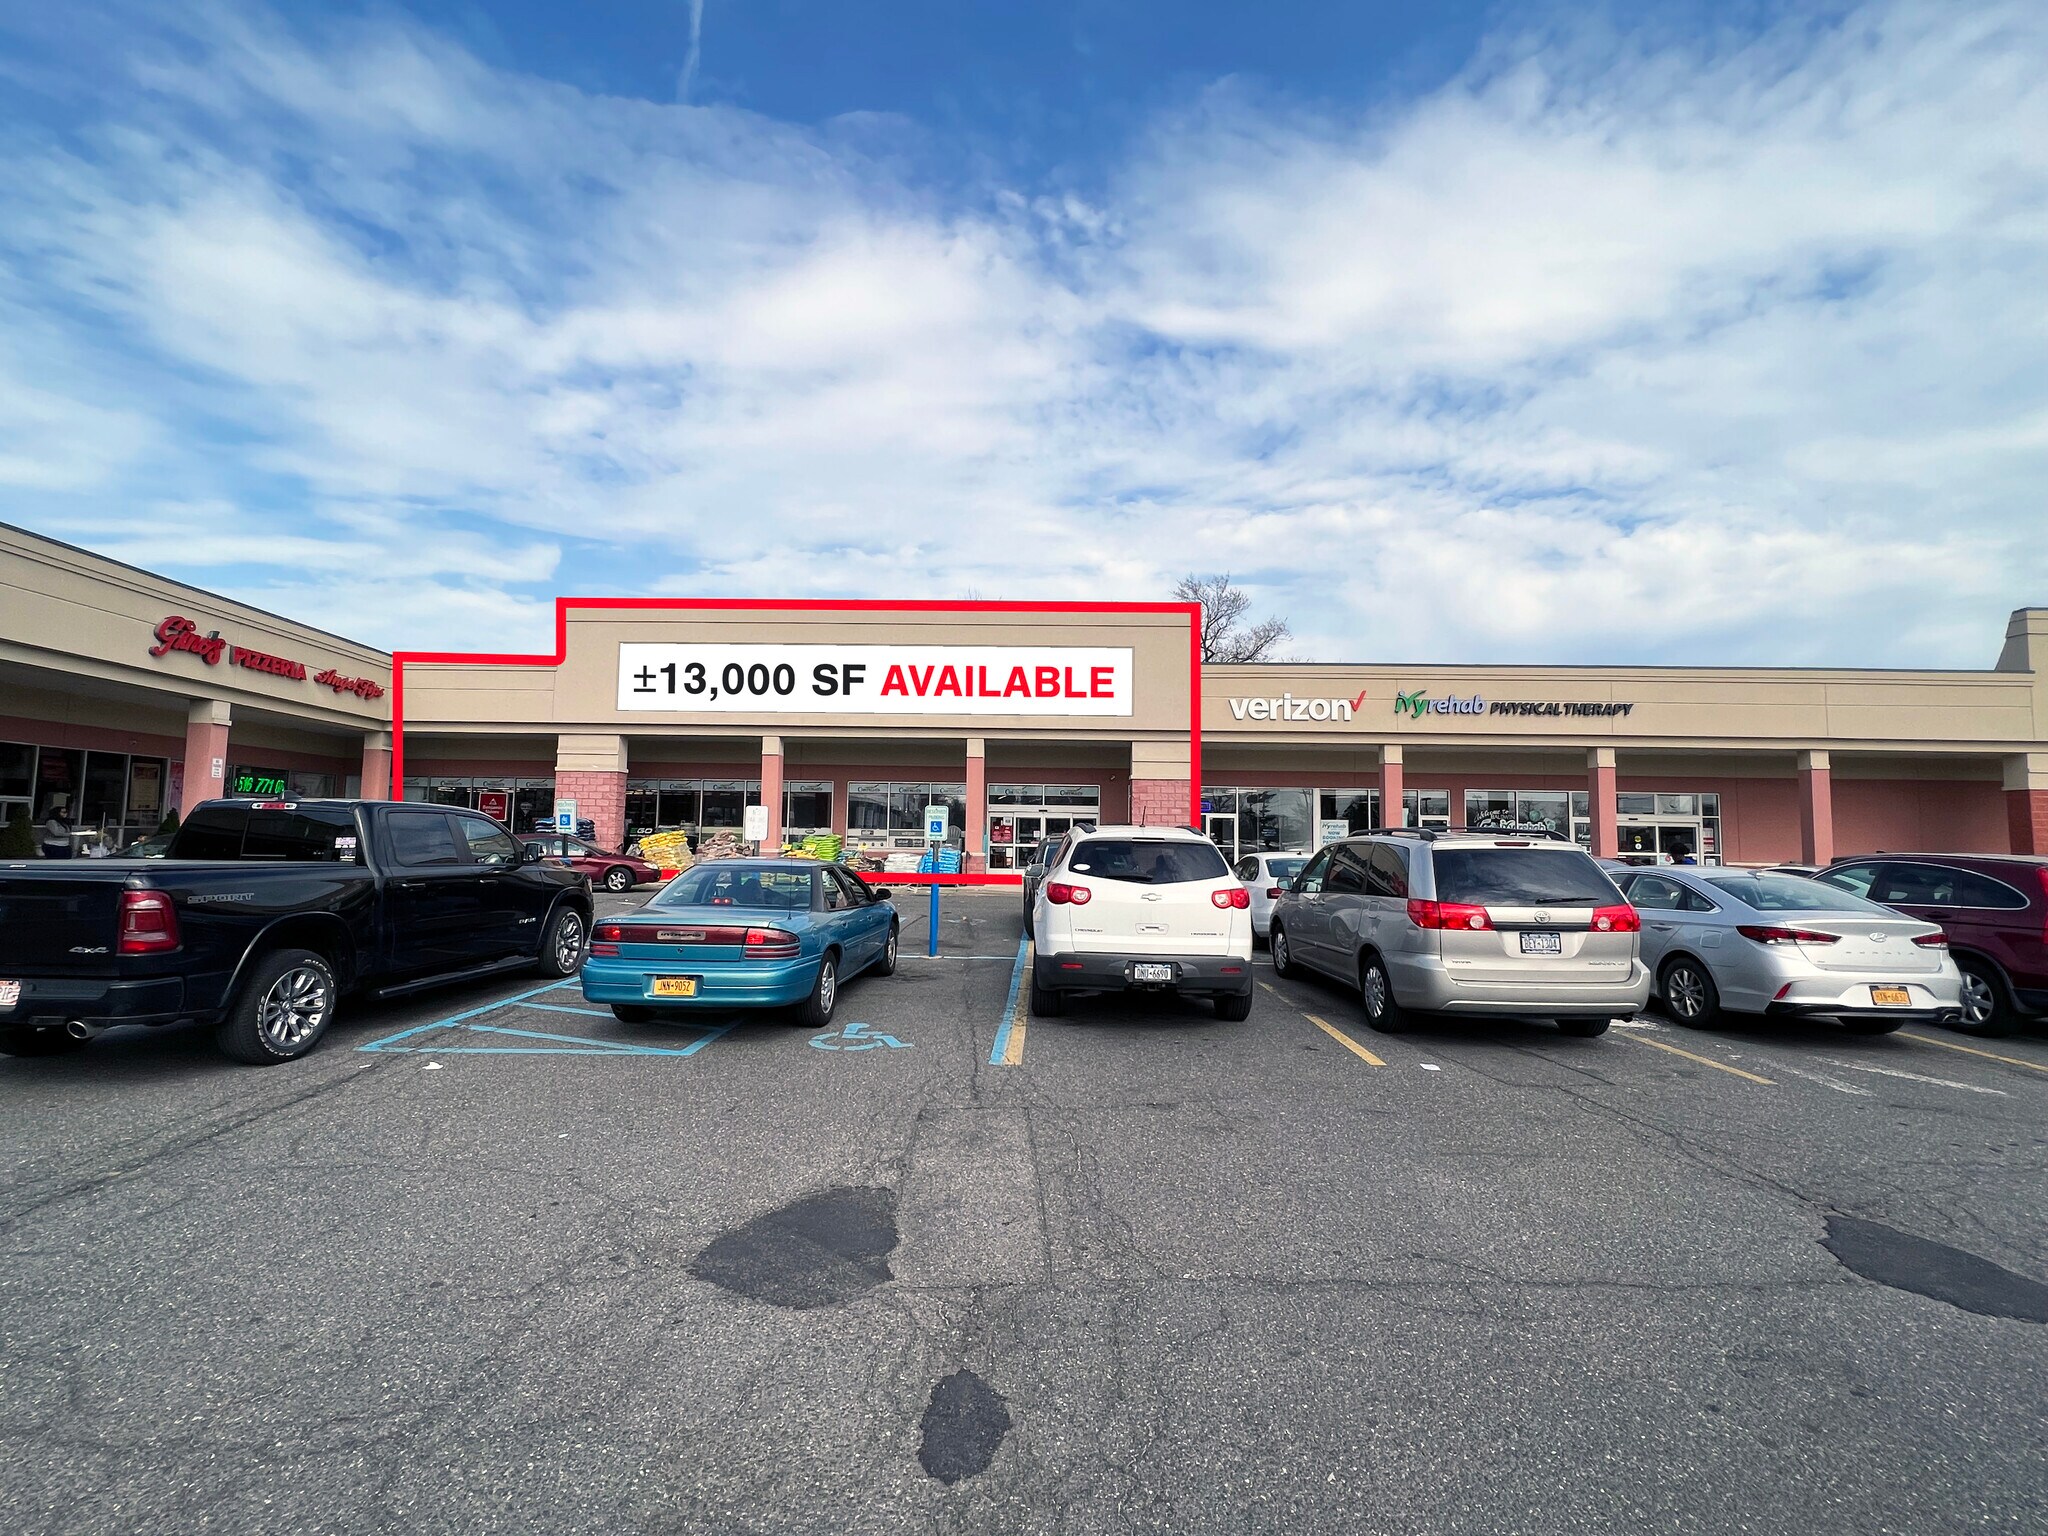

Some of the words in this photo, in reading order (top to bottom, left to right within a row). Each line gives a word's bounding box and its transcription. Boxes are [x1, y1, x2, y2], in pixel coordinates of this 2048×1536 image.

[230, 646, 307, 681] PIZZERIA
[1229, 692, 1351, 721] verizon
[1490, 702, 1562, 716] PHYSICAL
[1563, 703, 1634, 717] THERAPY
[187, 892, 255, 904] SPORT
